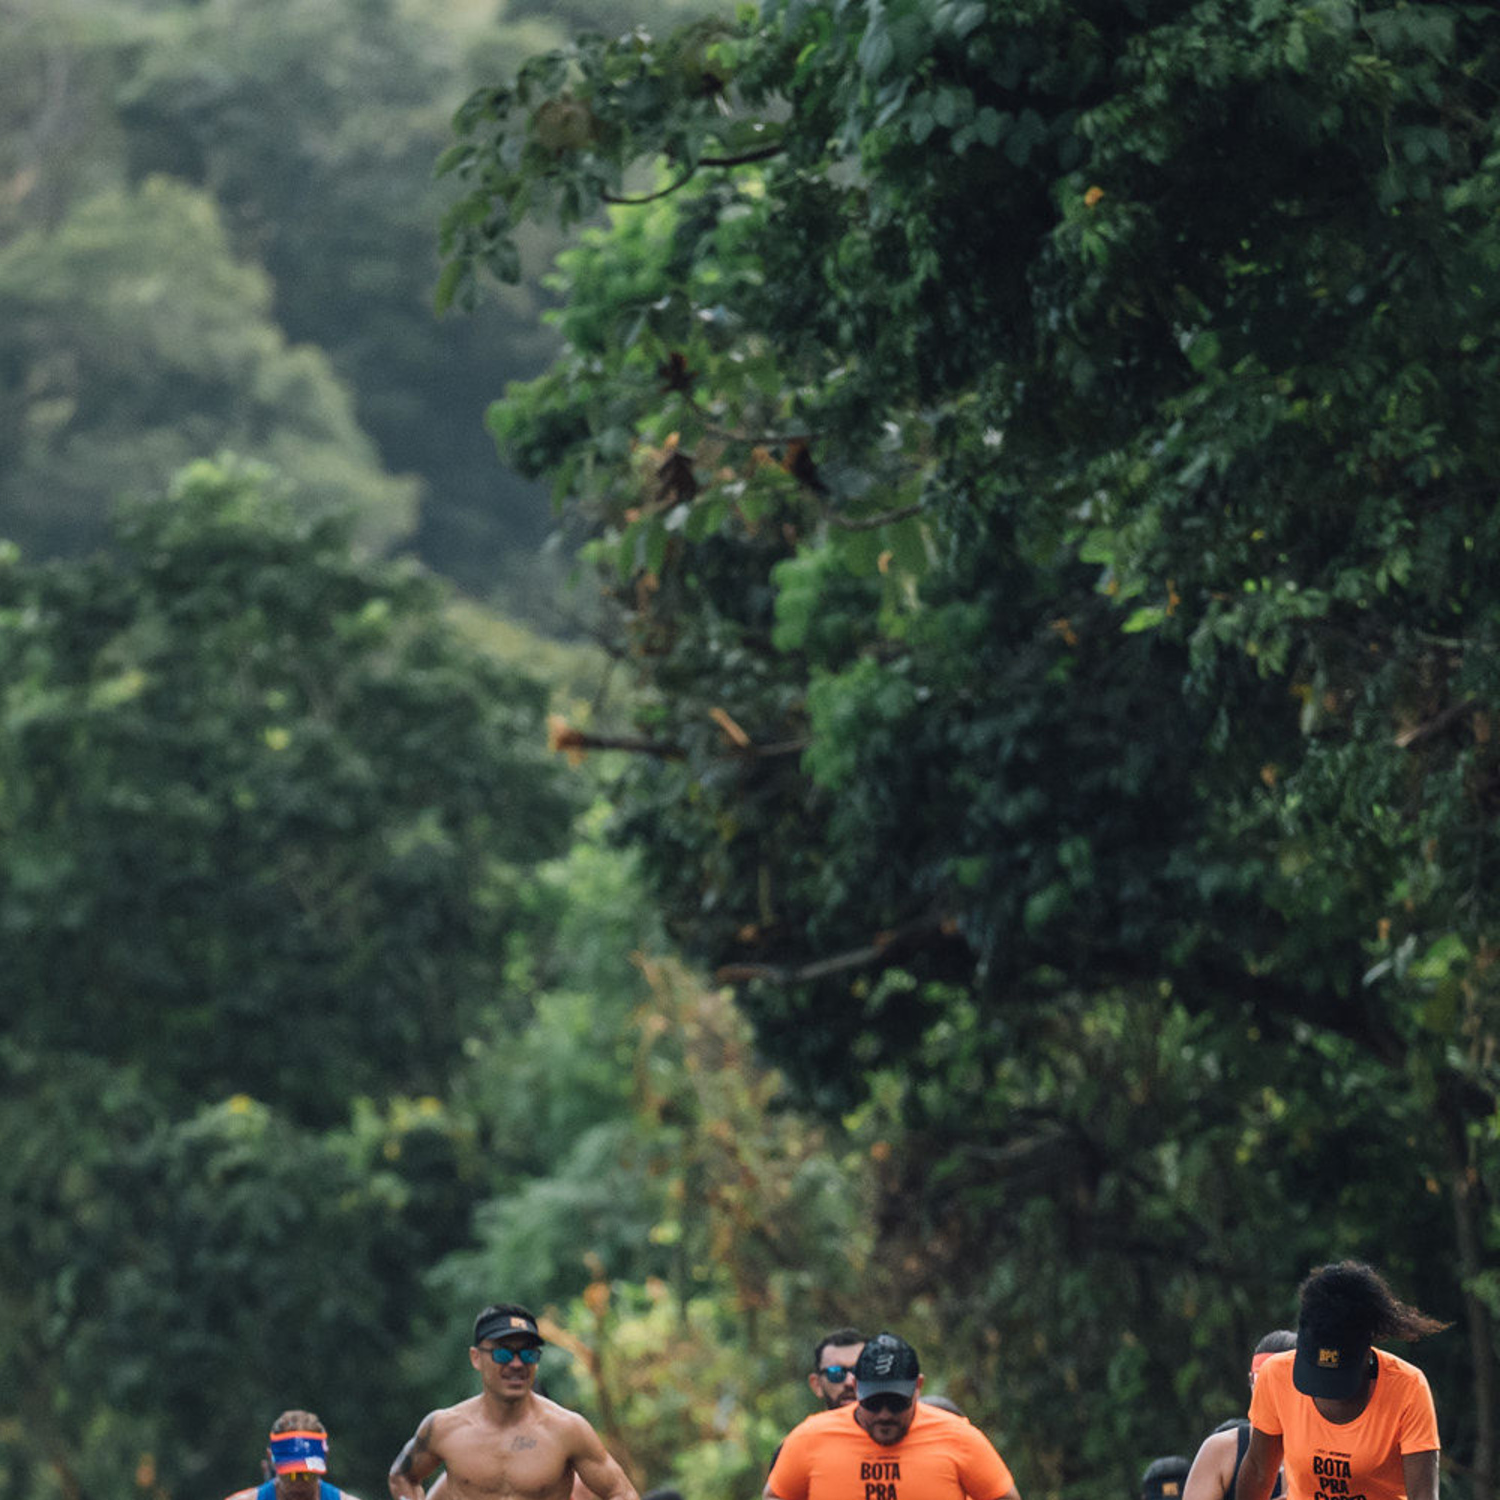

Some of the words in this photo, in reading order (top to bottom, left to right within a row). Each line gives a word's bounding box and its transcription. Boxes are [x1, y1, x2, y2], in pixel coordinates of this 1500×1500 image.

[861, 1462, 901, 1481] BOTA
[1313, 1456, 1352, 1478] BOTA
[865, 1482, 898, 1500] PRA
[1319, 1476, 1349, 1495] PRA
